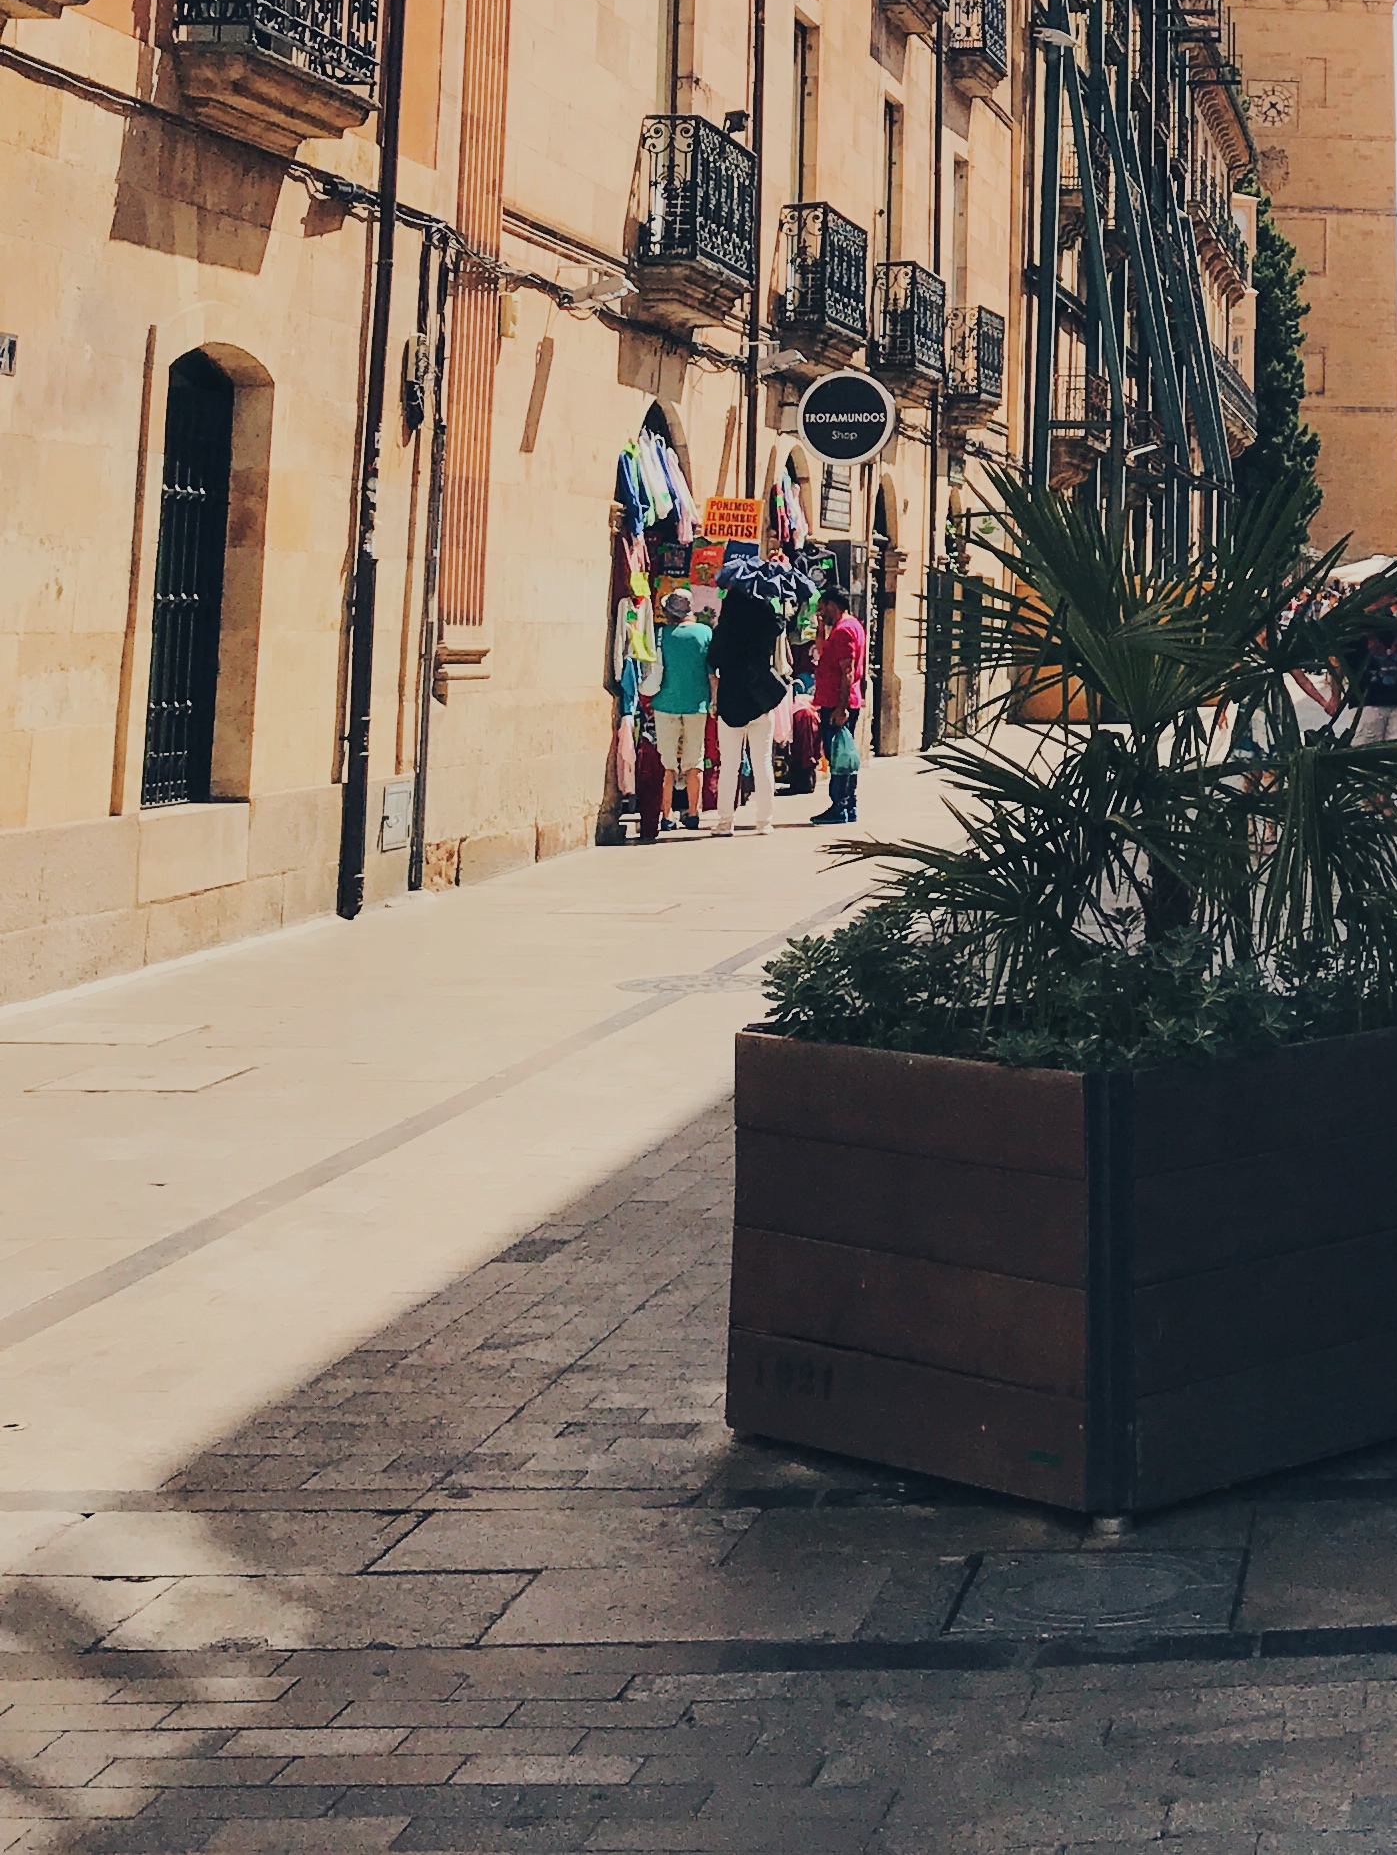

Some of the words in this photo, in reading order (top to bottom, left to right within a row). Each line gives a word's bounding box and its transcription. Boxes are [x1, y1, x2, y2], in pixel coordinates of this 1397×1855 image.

[805, 412, 886, 423] TROTAMUNDOS
[831, 430, 858, 441] Shop
[710, 500, 755, 513] PONEMOS
[718, 512, 758, 524] NOMBRE
[704, 522, 758, 539] ¡GRATIS!
